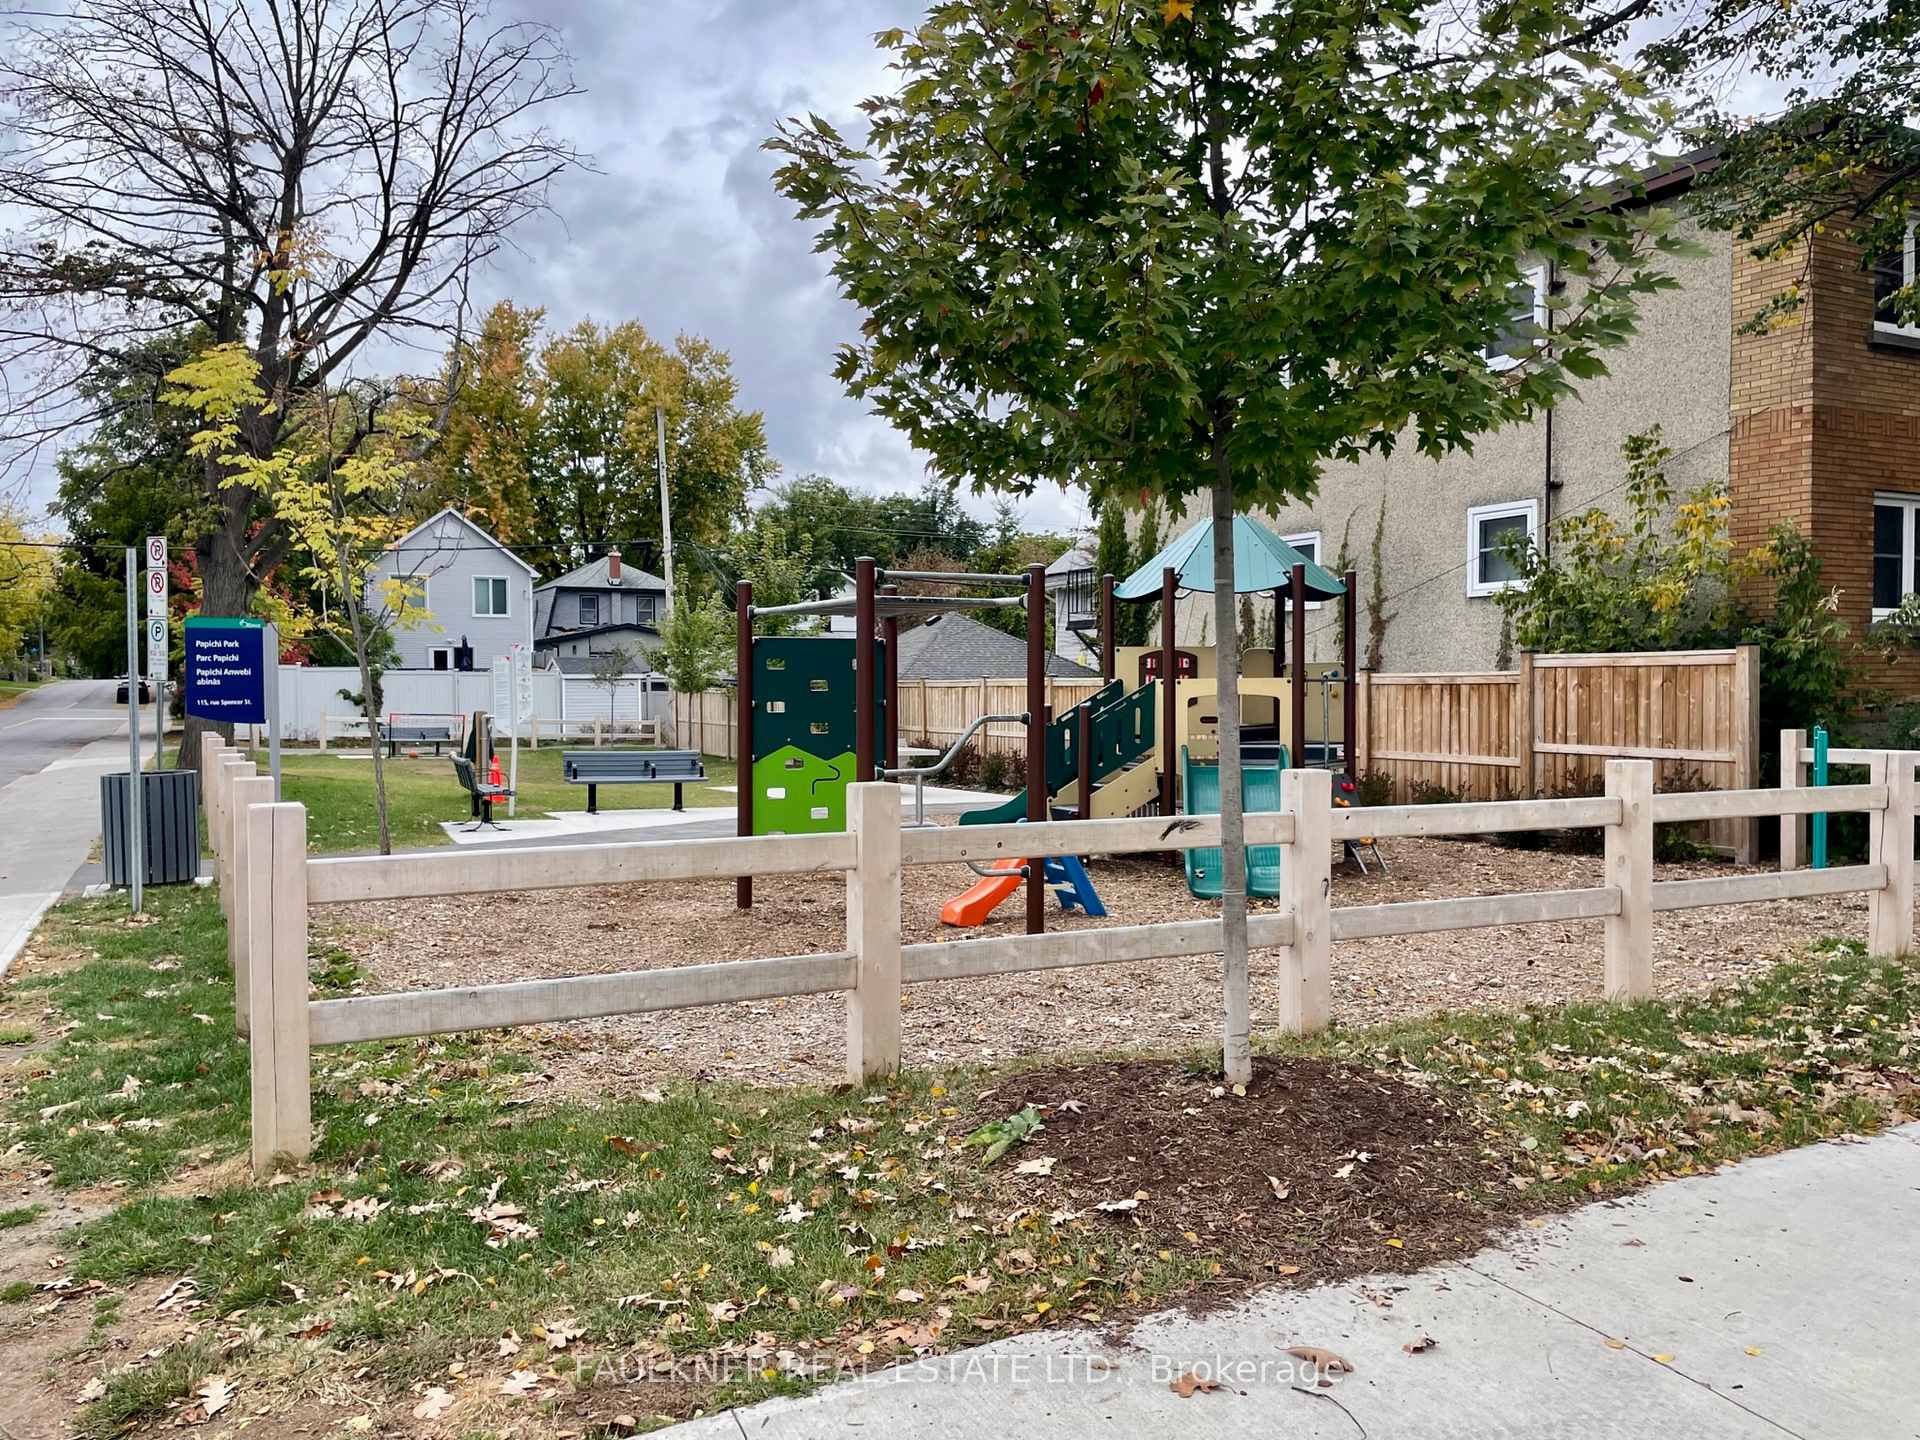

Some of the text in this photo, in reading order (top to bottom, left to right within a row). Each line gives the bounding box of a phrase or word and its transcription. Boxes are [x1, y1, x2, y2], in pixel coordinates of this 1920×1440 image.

[195, 640, 240, 649] Papichi Park
[196, 654, 239, 663] Parc Papichi
[196, 668, 252, 677] Papichi Anwebi
